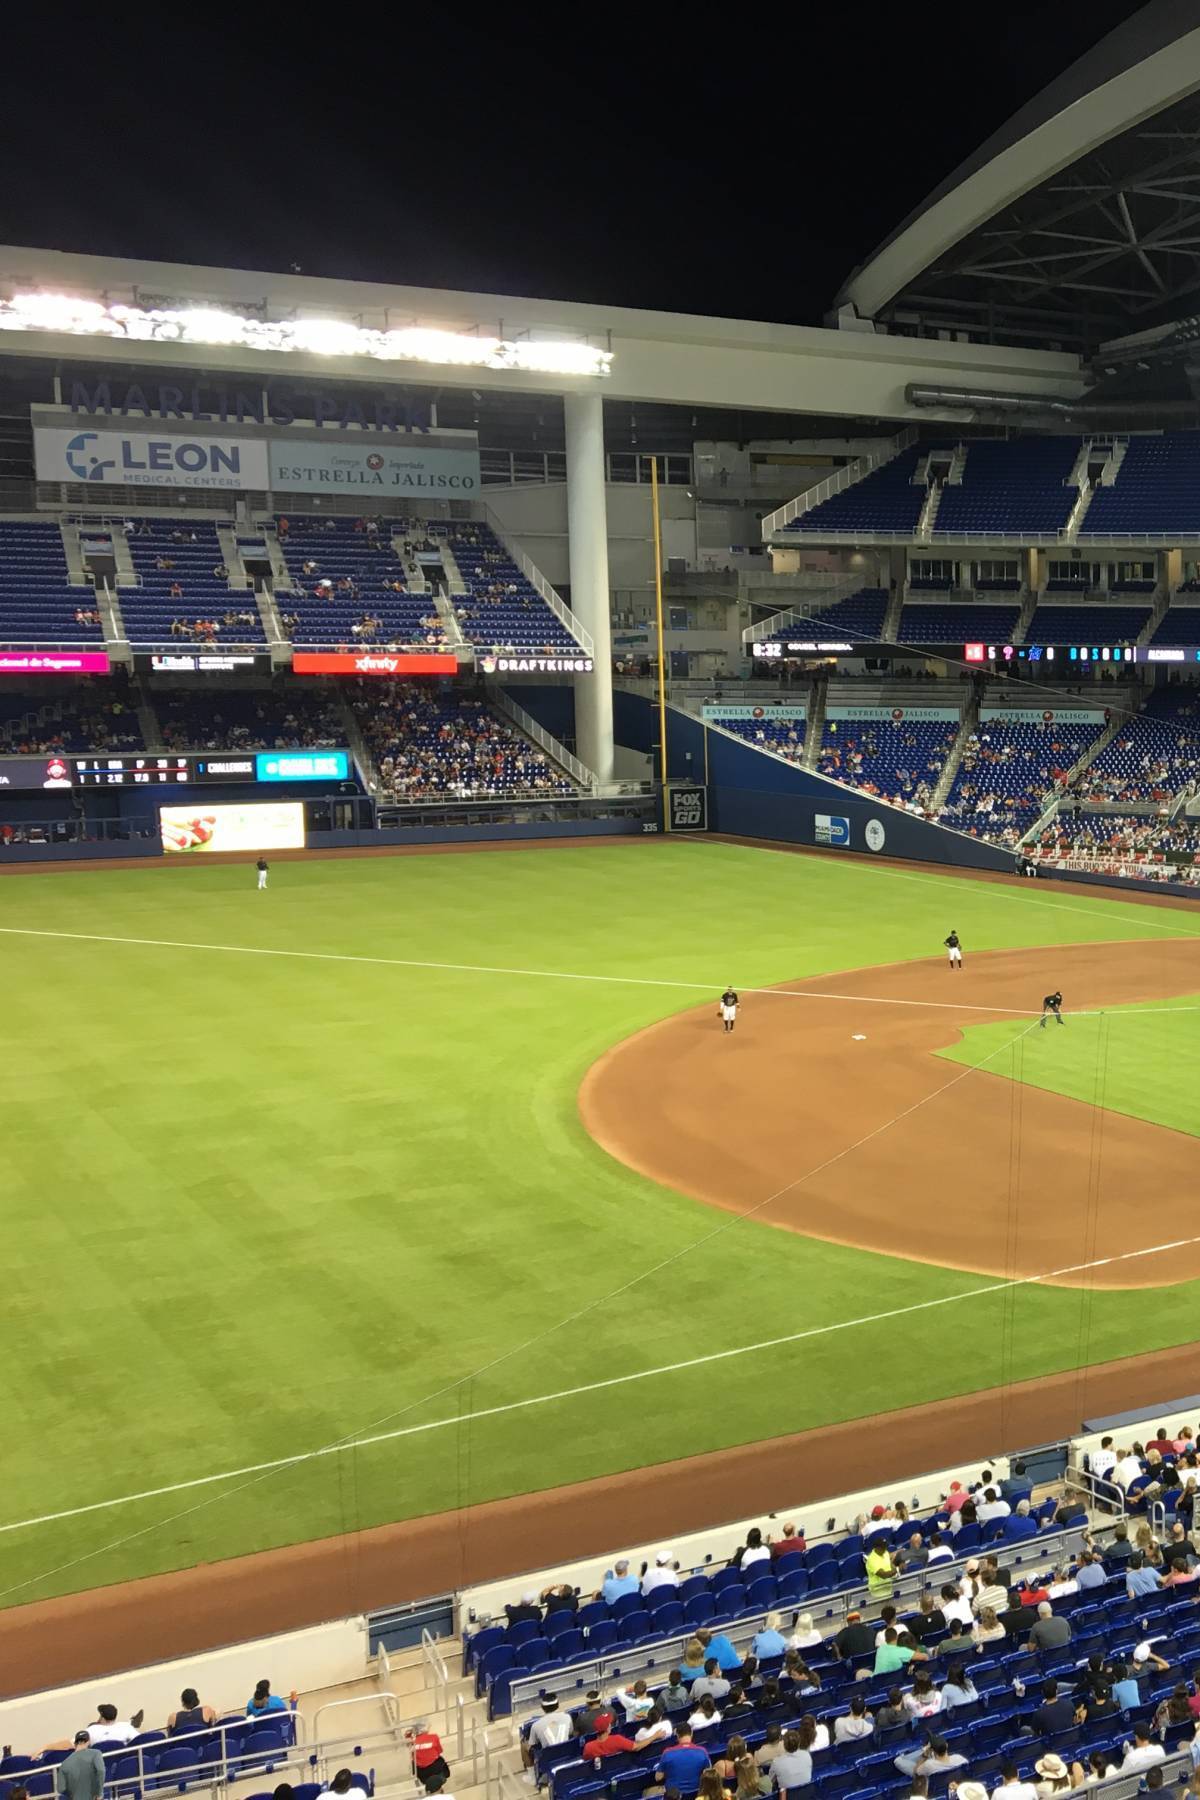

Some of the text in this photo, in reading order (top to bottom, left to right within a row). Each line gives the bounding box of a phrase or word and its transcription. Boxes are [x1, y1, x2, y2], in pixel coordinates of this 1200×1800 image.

[71, 381, 430, 434] MARLINS PARK
[122, 441, 240, 474] LEON
[123, 474, 240, 487] MEDICAL CENTERS
[279, 467, 474, 489] ESTRELLA JALISCO
[355, 656, 398, 672] xfinity
[499, 659, 593, 672] DRAFTKINGS
[706, 708, 750, 716] ESTRELLA
[673, 793, 701, 806] FOX
[674, 811, 701, 825] GO
[642, 822, 658, 832] 335
[1064, 860, 1081, 870] THIS
